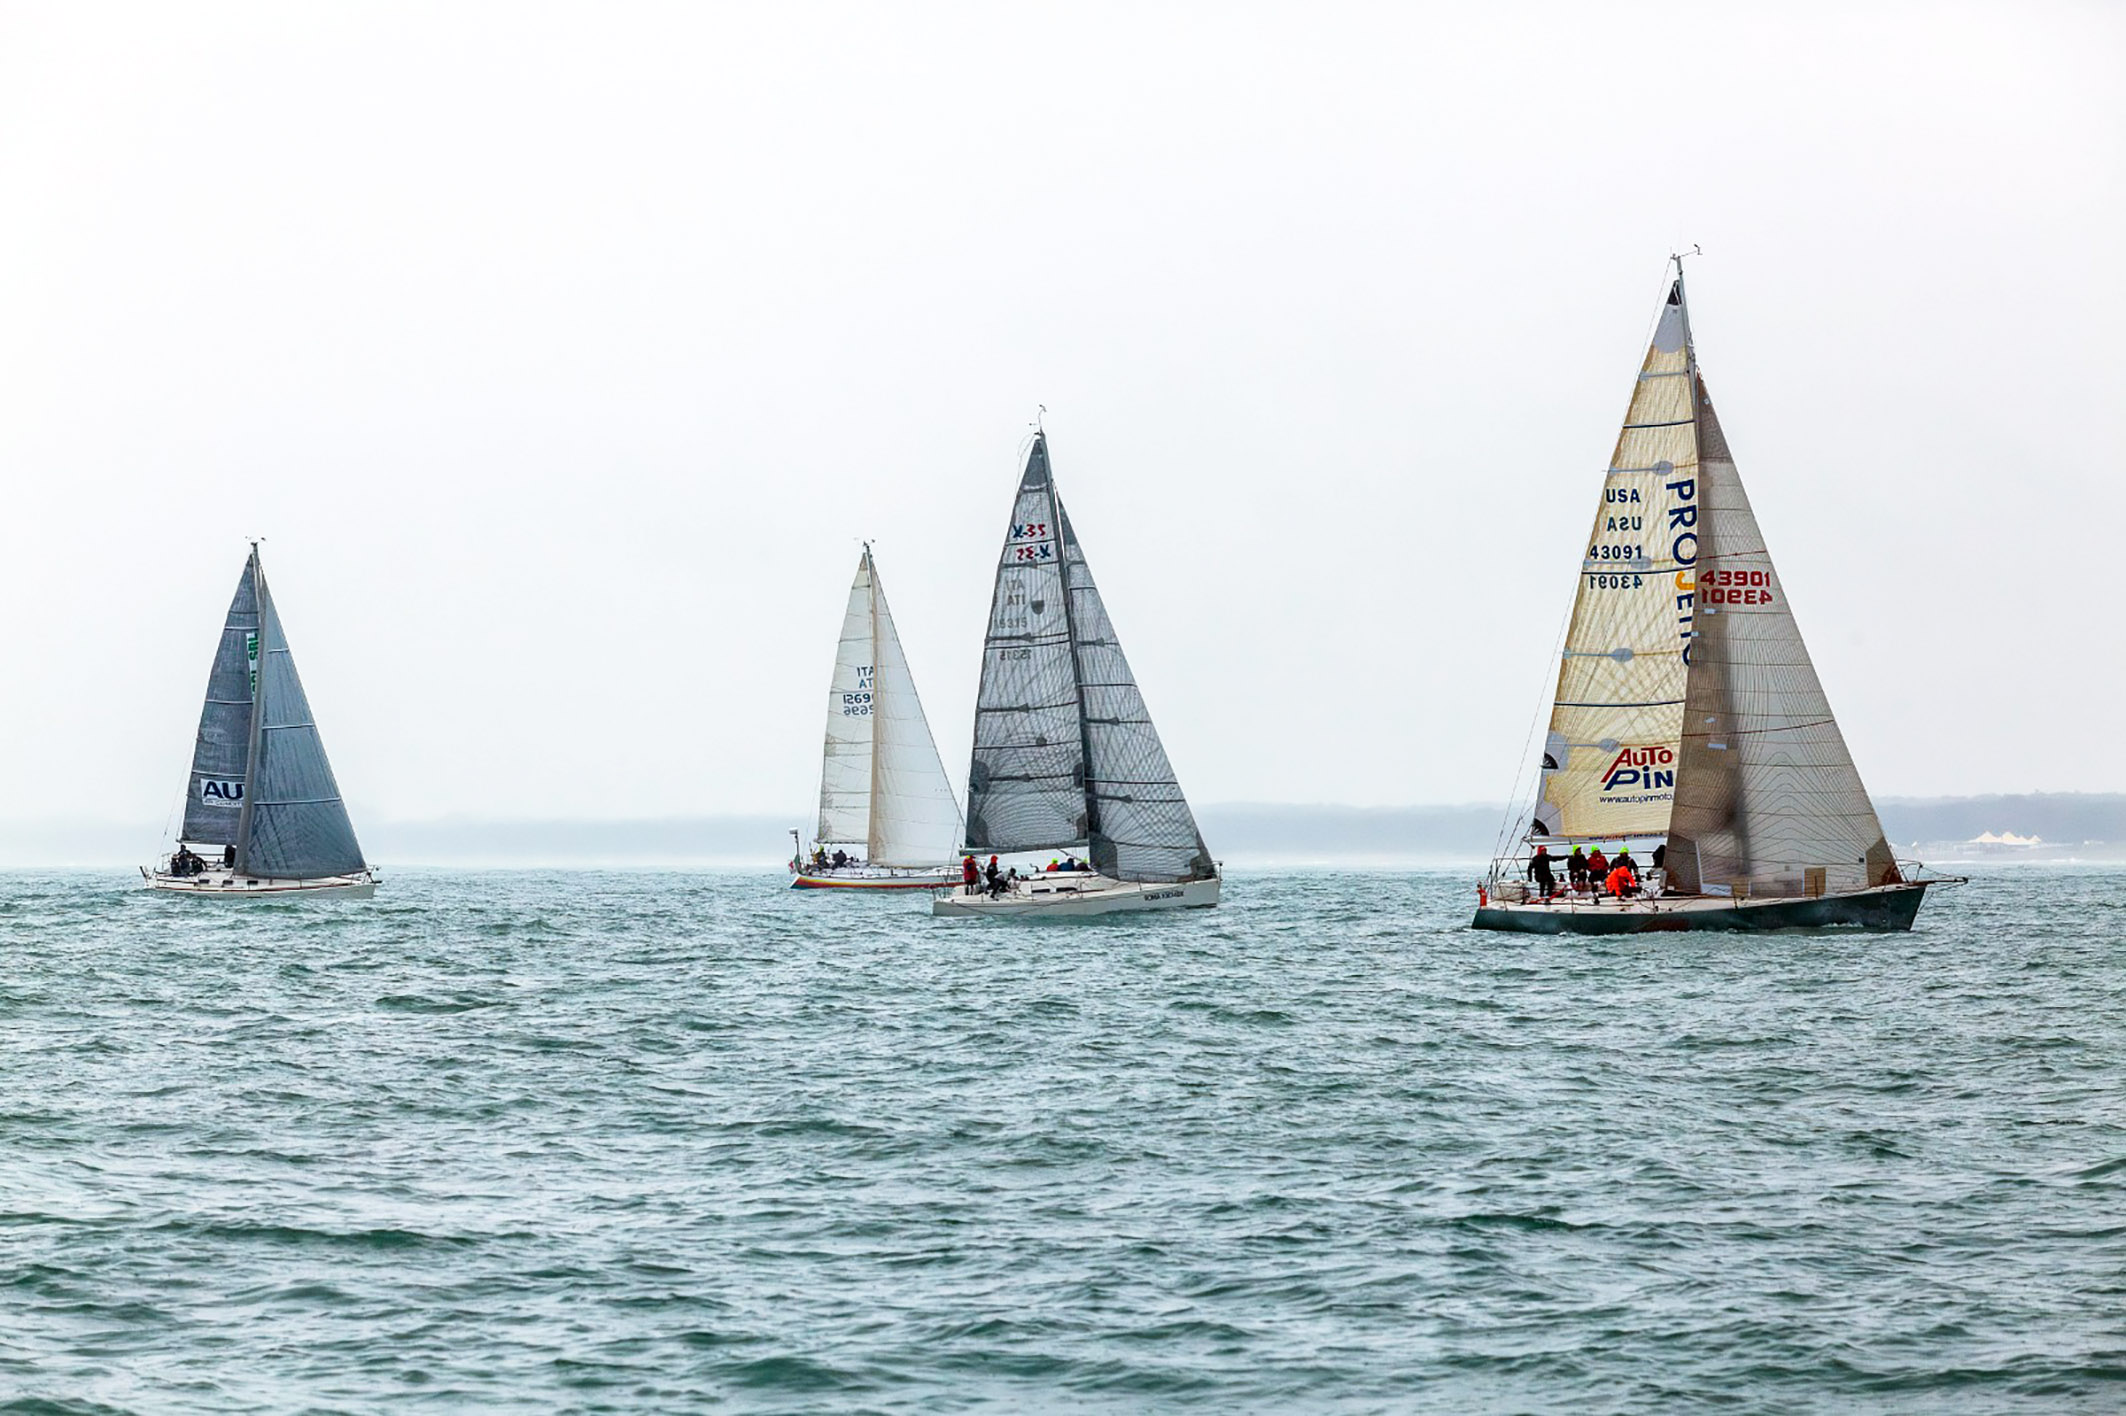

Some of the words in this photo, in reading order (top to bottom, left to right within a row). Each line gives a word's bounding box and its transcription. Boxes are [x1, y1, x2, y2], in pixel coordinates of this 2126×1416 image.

[1606, 488, 1640, 503] USA
[1012, 523, 1046, 538] X-35
[1590, 545, 1642, 560] 43091
[1700, 570, 1770, 588] 43901
[843, 693, 874, 704] 1269
[203, 780, 246, 800] AU
